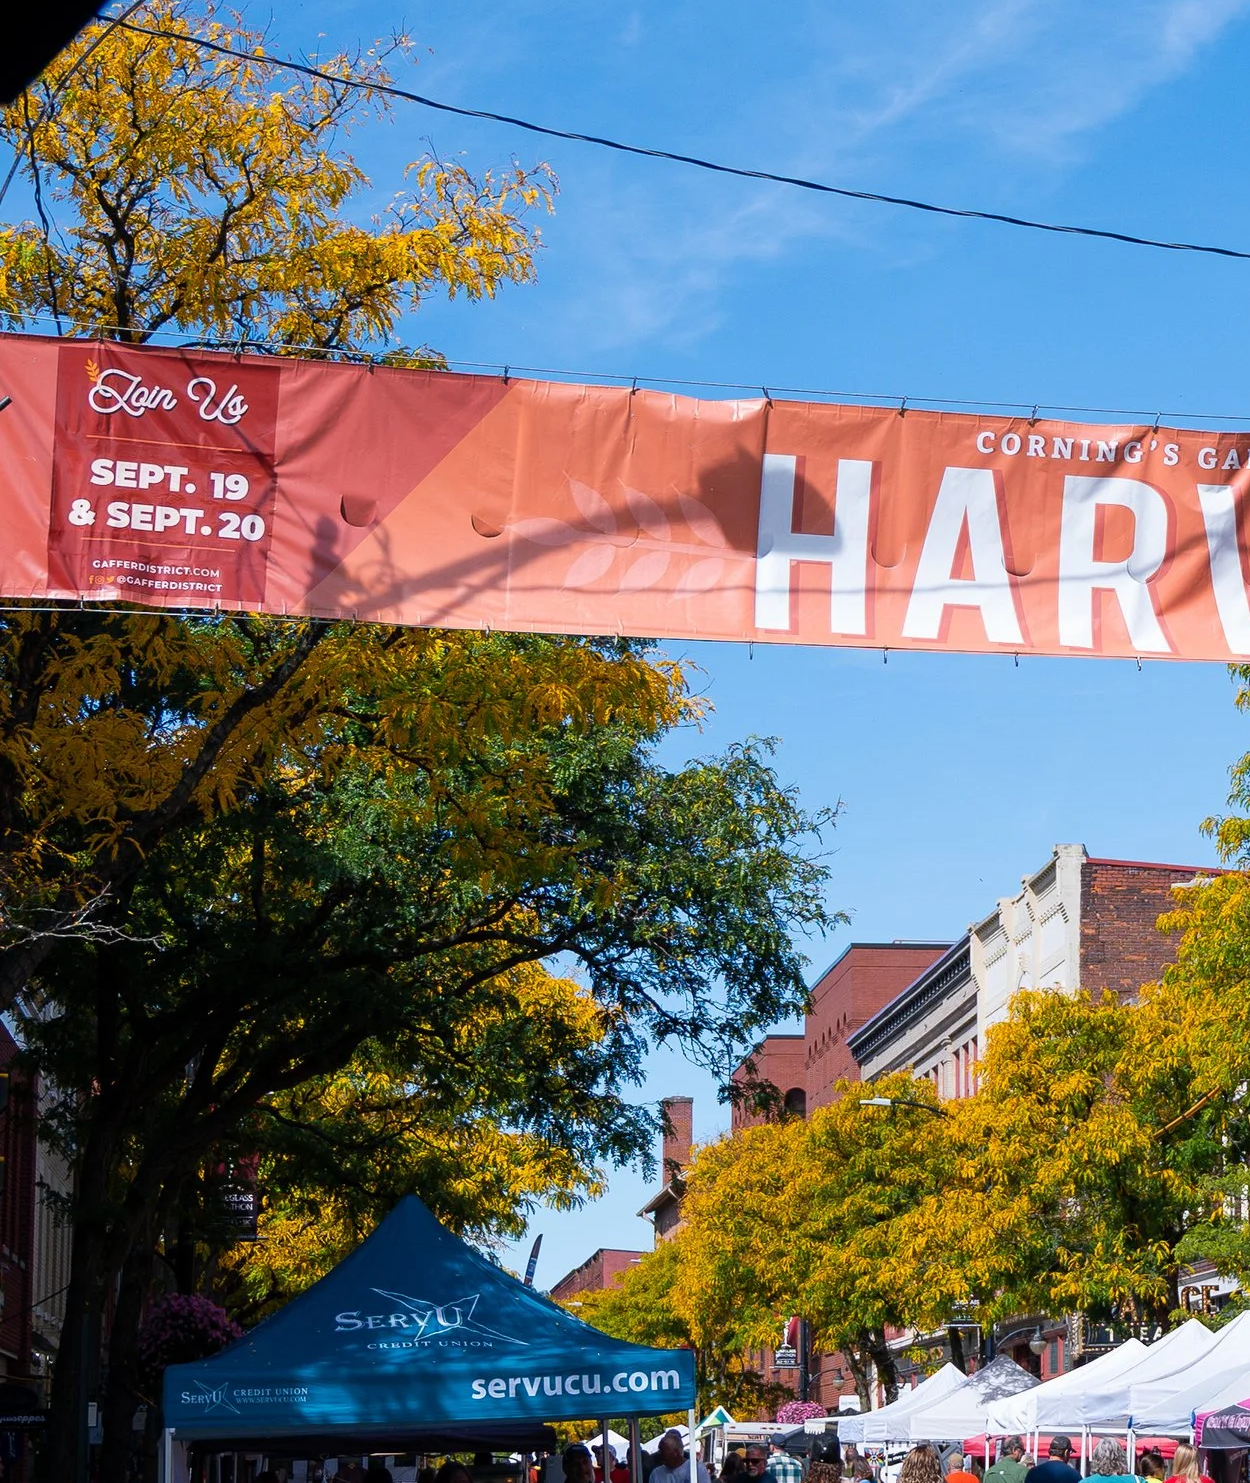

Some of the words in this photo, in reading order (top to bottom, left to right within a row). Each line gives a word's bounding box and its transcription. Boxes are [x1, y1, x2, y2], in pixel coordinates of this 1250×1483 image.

[88, 368, 177, 417] Join
[187, 377, 249, 425] Us
[976, 431, 1180, 466] CORNING'S
[90, 458, 197, 494] SEPT.
[210, 473, 249, 501] 19
[68, 499, 96, 526] &
[106, 502, 212, 536] SEPT.
[218, 512, 266, 542] 20
[92, 559, 220, 578] GAFFERDISTRICT.COM
[116, 576, 222, 593] @GAFFERDISTRICT
[367, 1341, 431, 1350] CREDIT
[439, 1340, 494, 1348] UNION
[233, 1388, 272, 1397] CREDIT
[275, 1387, 308, 1396] UNION
[471, 1369, 680, 1400] servucu.com
